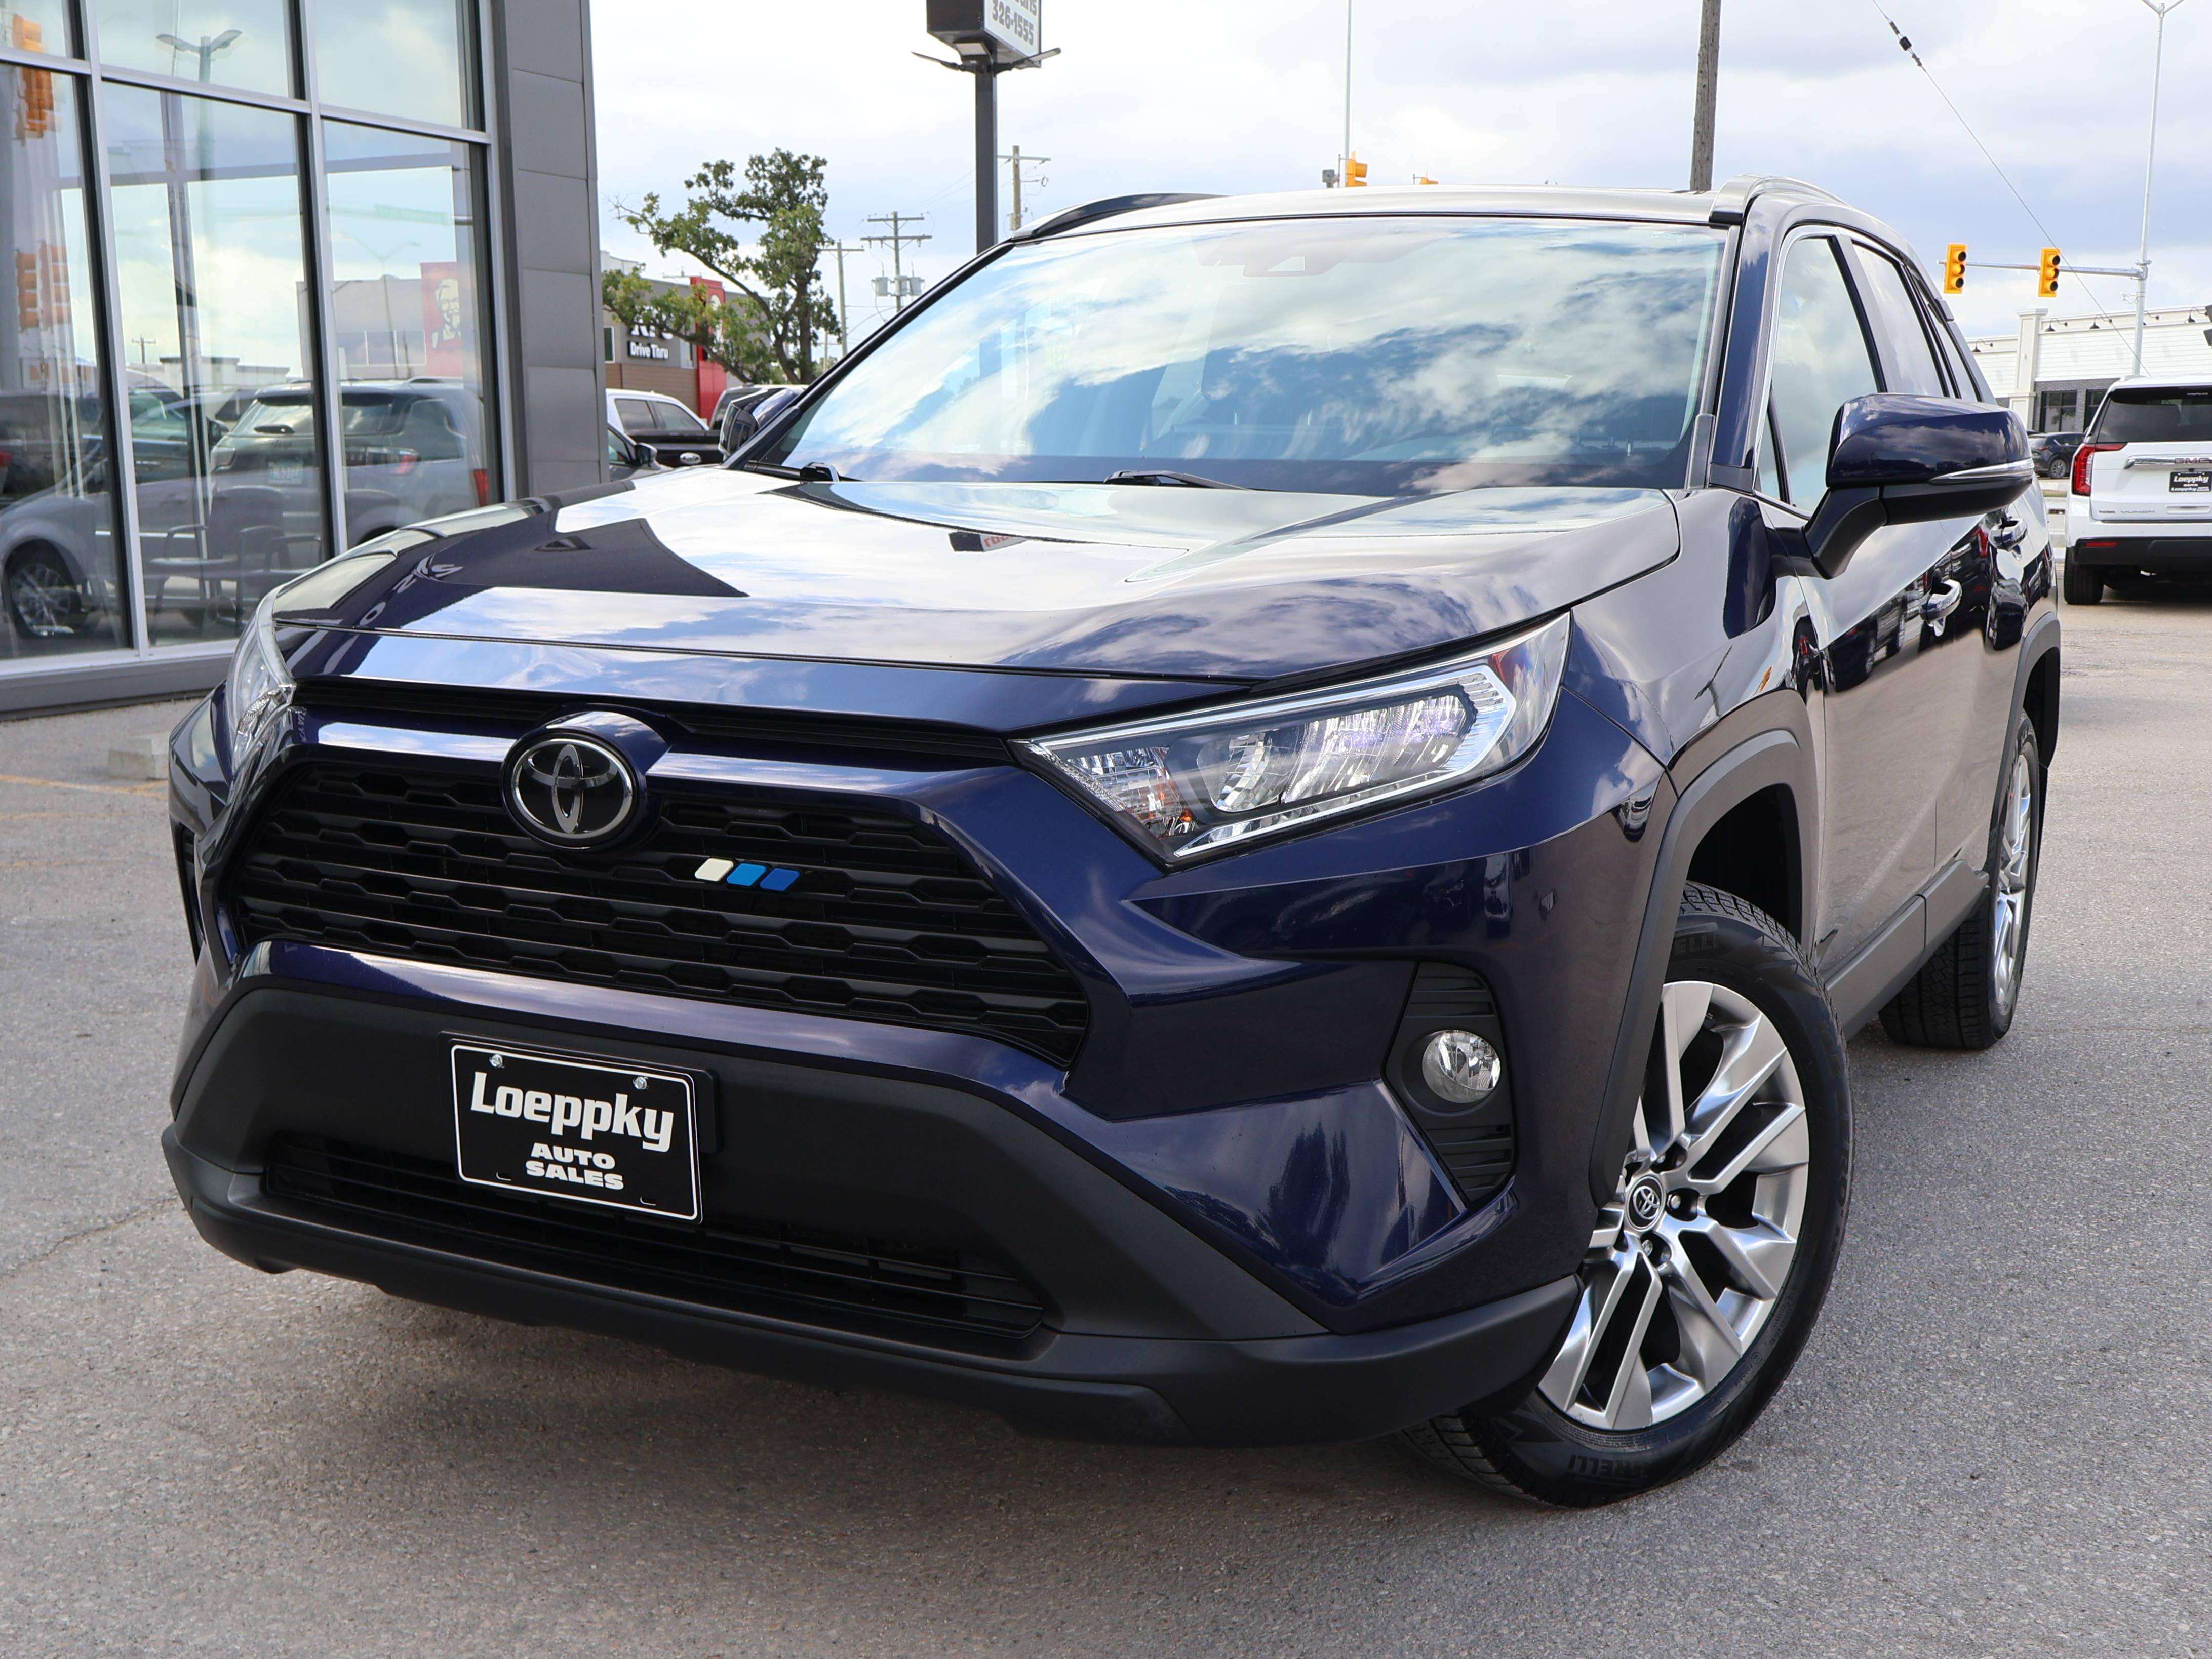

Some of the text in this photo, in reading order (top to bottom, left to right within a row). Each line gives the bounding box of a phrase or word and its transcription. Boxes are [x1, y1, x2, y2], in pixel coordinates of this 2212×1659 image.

[992, 0, 1034, 46] 326-1555
[630, 341, 668, 358] Drive Thru
[471, 1071, 674, 1152] Loeppky
[531, 1142, 615, 1169] AUTO
[526, 1160, 624, 1190] SALES
